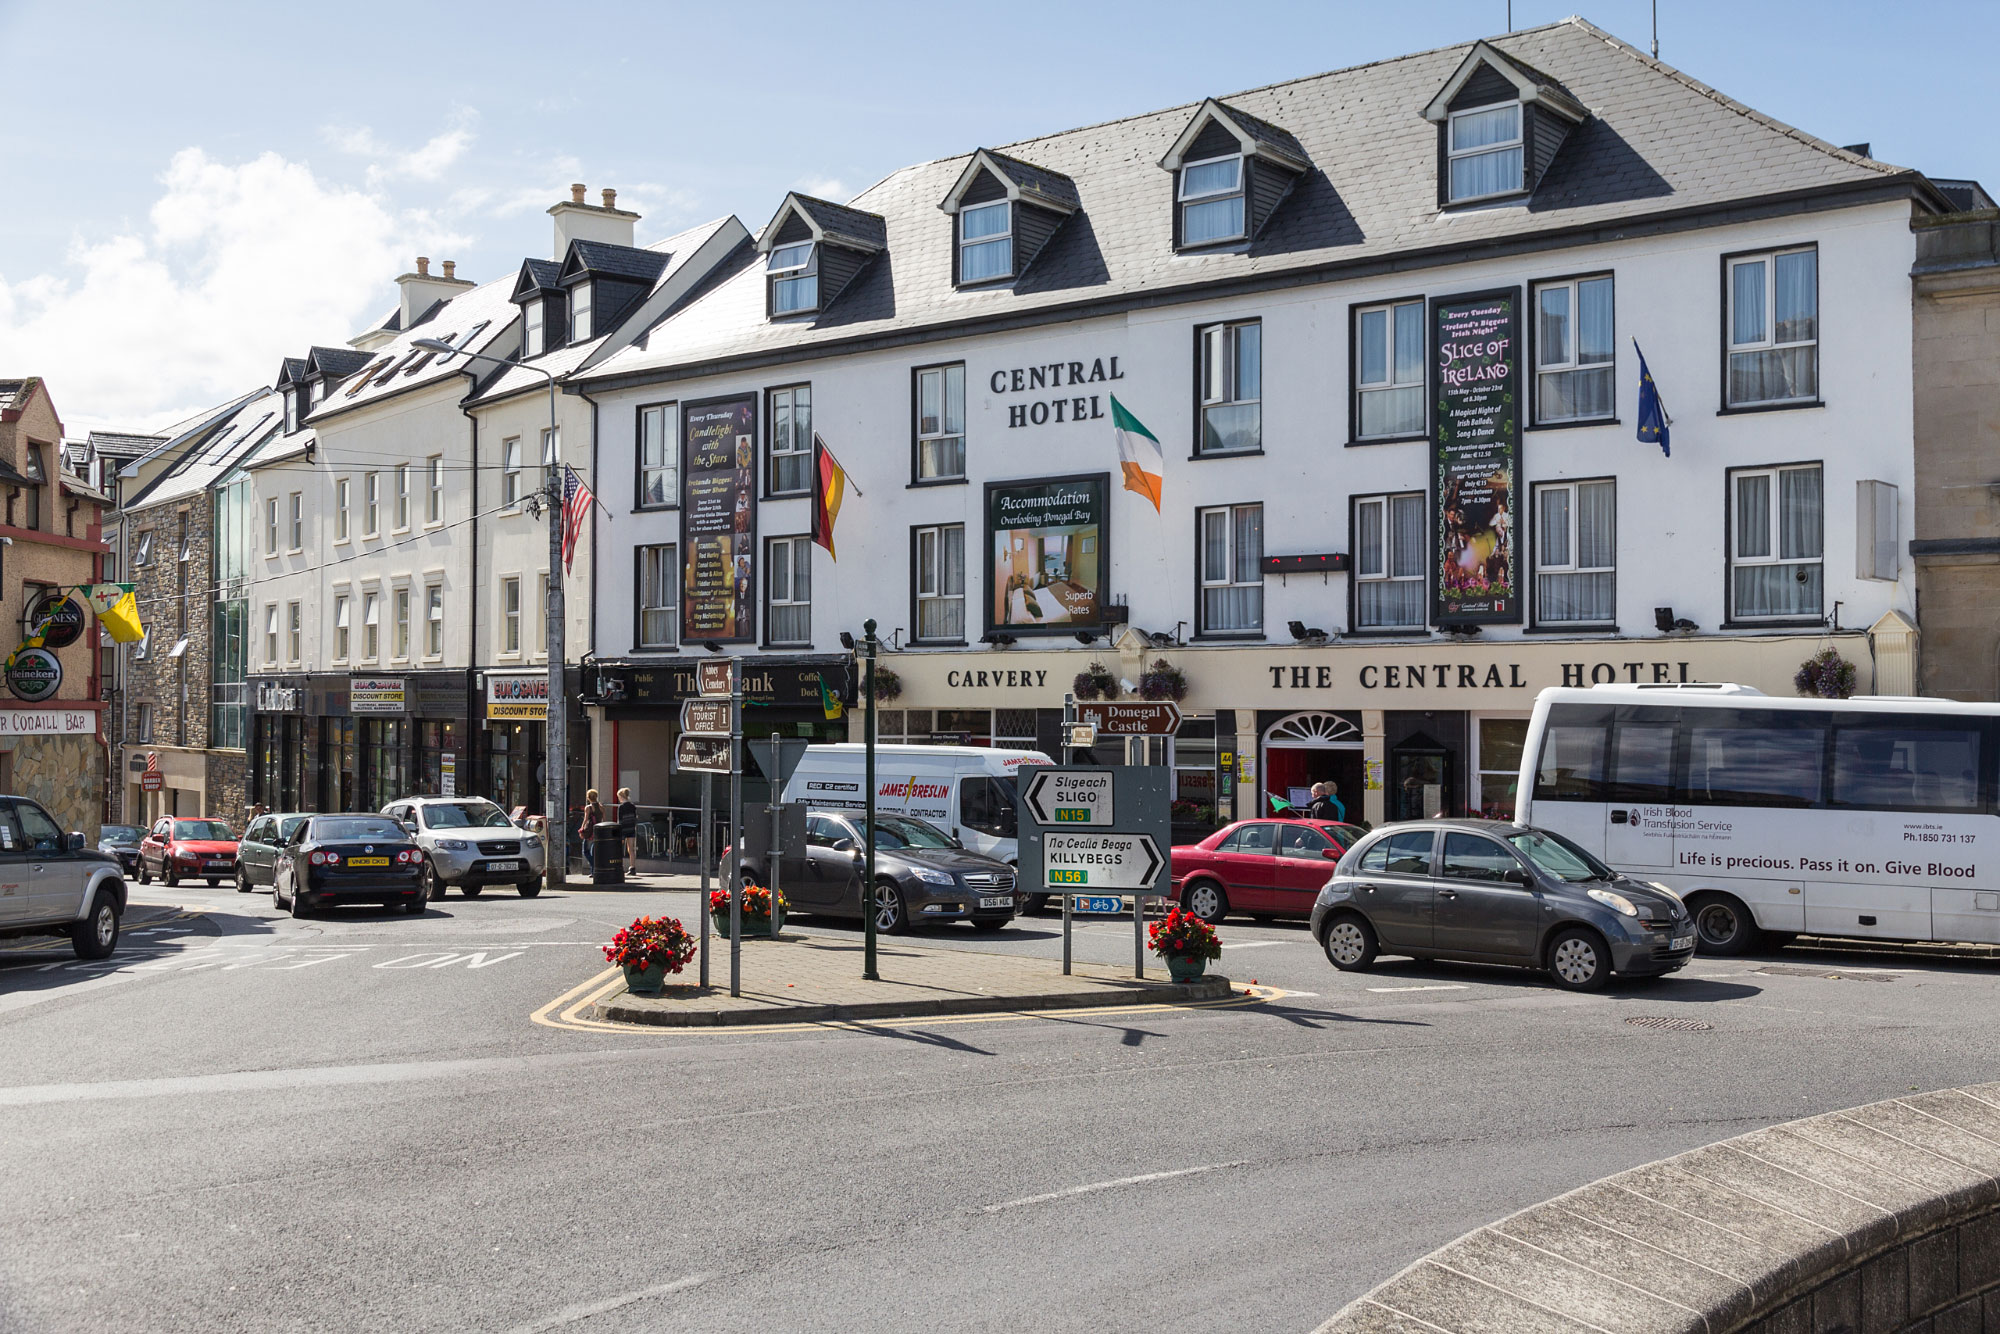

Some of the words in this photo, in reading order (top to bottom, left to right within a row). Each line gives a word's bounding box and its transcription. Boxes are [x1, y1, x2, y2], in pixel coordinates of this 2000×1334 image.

[1448, 310, 1469, 319] Every
[1470, 306, 1502, 318] Tuesday
[1480, 317, 1508, 328] Biggest
[1451, 329, 1471, 338] Irish
[990, 356, 1124, 394] CENTRAL
[1008, 396, 1104, 428] HOTEL
[1449, 409, 1454, 417] A
[1454, 407, 1478, 418] Magical
[1478, 406, 1494, 416] Night
[1494, 404, 1502, 413] of
[1457, 420, 1470, 428] Irish
[690, 424, 733, 441] Candlelight
[1456, 430, 1471, 439] Song
[702, 439, 719, 451] with
[693, 455, 705, 466] the
[705, 454, 728, 467] Stars
[1000, 488, 1090, 511] Accommodation
[1000, 512, 1042, 527] Overlooking
[1043, 510, 1073, 524] Donegal
[1074, 510, 1091, 524] Bay
[1064, 590, 1093, 605] Superb
[1068, 604, 1090, 615] Rates
[34, 612, 78, 624] GUNESS
[11, 670, 55, 678] Heineken
[705, 664, 719, 678] Abbey
[1269, 666, 1332, 688] THE
[1358, 664, 1527, 688] CENTRAL
[1560, 661, 1696, 688] HOTEL
[634, 674, 654, 682] Public
[674, 672, 697, 692] Th
[742, 672, 774, 692] ank
[947, 670, 1048, 688] CARVERY
[705, 678, 726, 691] Cemetery
[638, 689, 649, 697] Bar
[801, 688, 819, 697] Dock
[494, 707, 528, 715] DISCOUNT
[529, 708, 547, 716] STOR
[694, 712, 717, 721] TOURIST
[1108, 706, 1160, 720] Donegal
[65, 712, 85, 731] BAR
[695, 722, 714, 731] OFFICE
[1108, 720, 1148, 732] Castle
[686, 741, 707, 750] DONEGAL
[680, 754, 694, 762] CRAFT
[694, 755, 712, 764] VILLAGE
[1055, 776, 1107, 792] Sligeach
[878, 783, 907, 798] JAMES
[912, 784, 949, 799] BRESLIN
[1056, 792, 1097, 803] SLIGO
[910, 810, 947, 818] CONTRACTOR
[1643, 807, 1662, 816] Irish
[1665, 808, 1692, 817] Blood
[1643, 819, 1695, 830] Transfusion
[1697, 821, 1733, 831] Service
[1904, 832, 1939, 842] Ph.1850
[1941, 834, 1956, 843] 731
[1960, 835, 1976, 843] 137
[1101, 839, 1132, 850] Beaga
[1050, 853, 1123, 865] KILLYBEGS
[1680, 852, 1706, 866] Life
[1711, 853, 1722, 866] is
[1727, 855, 1794, 873] precious.
[1800, 857, 1833, 871] Pass
[1838, 858, 1849, 872] it
[1854, 860, 1881, 874] on.
[1884, 860, 1920, 876] Give
[1928, 862, 1975, 878] Blood
